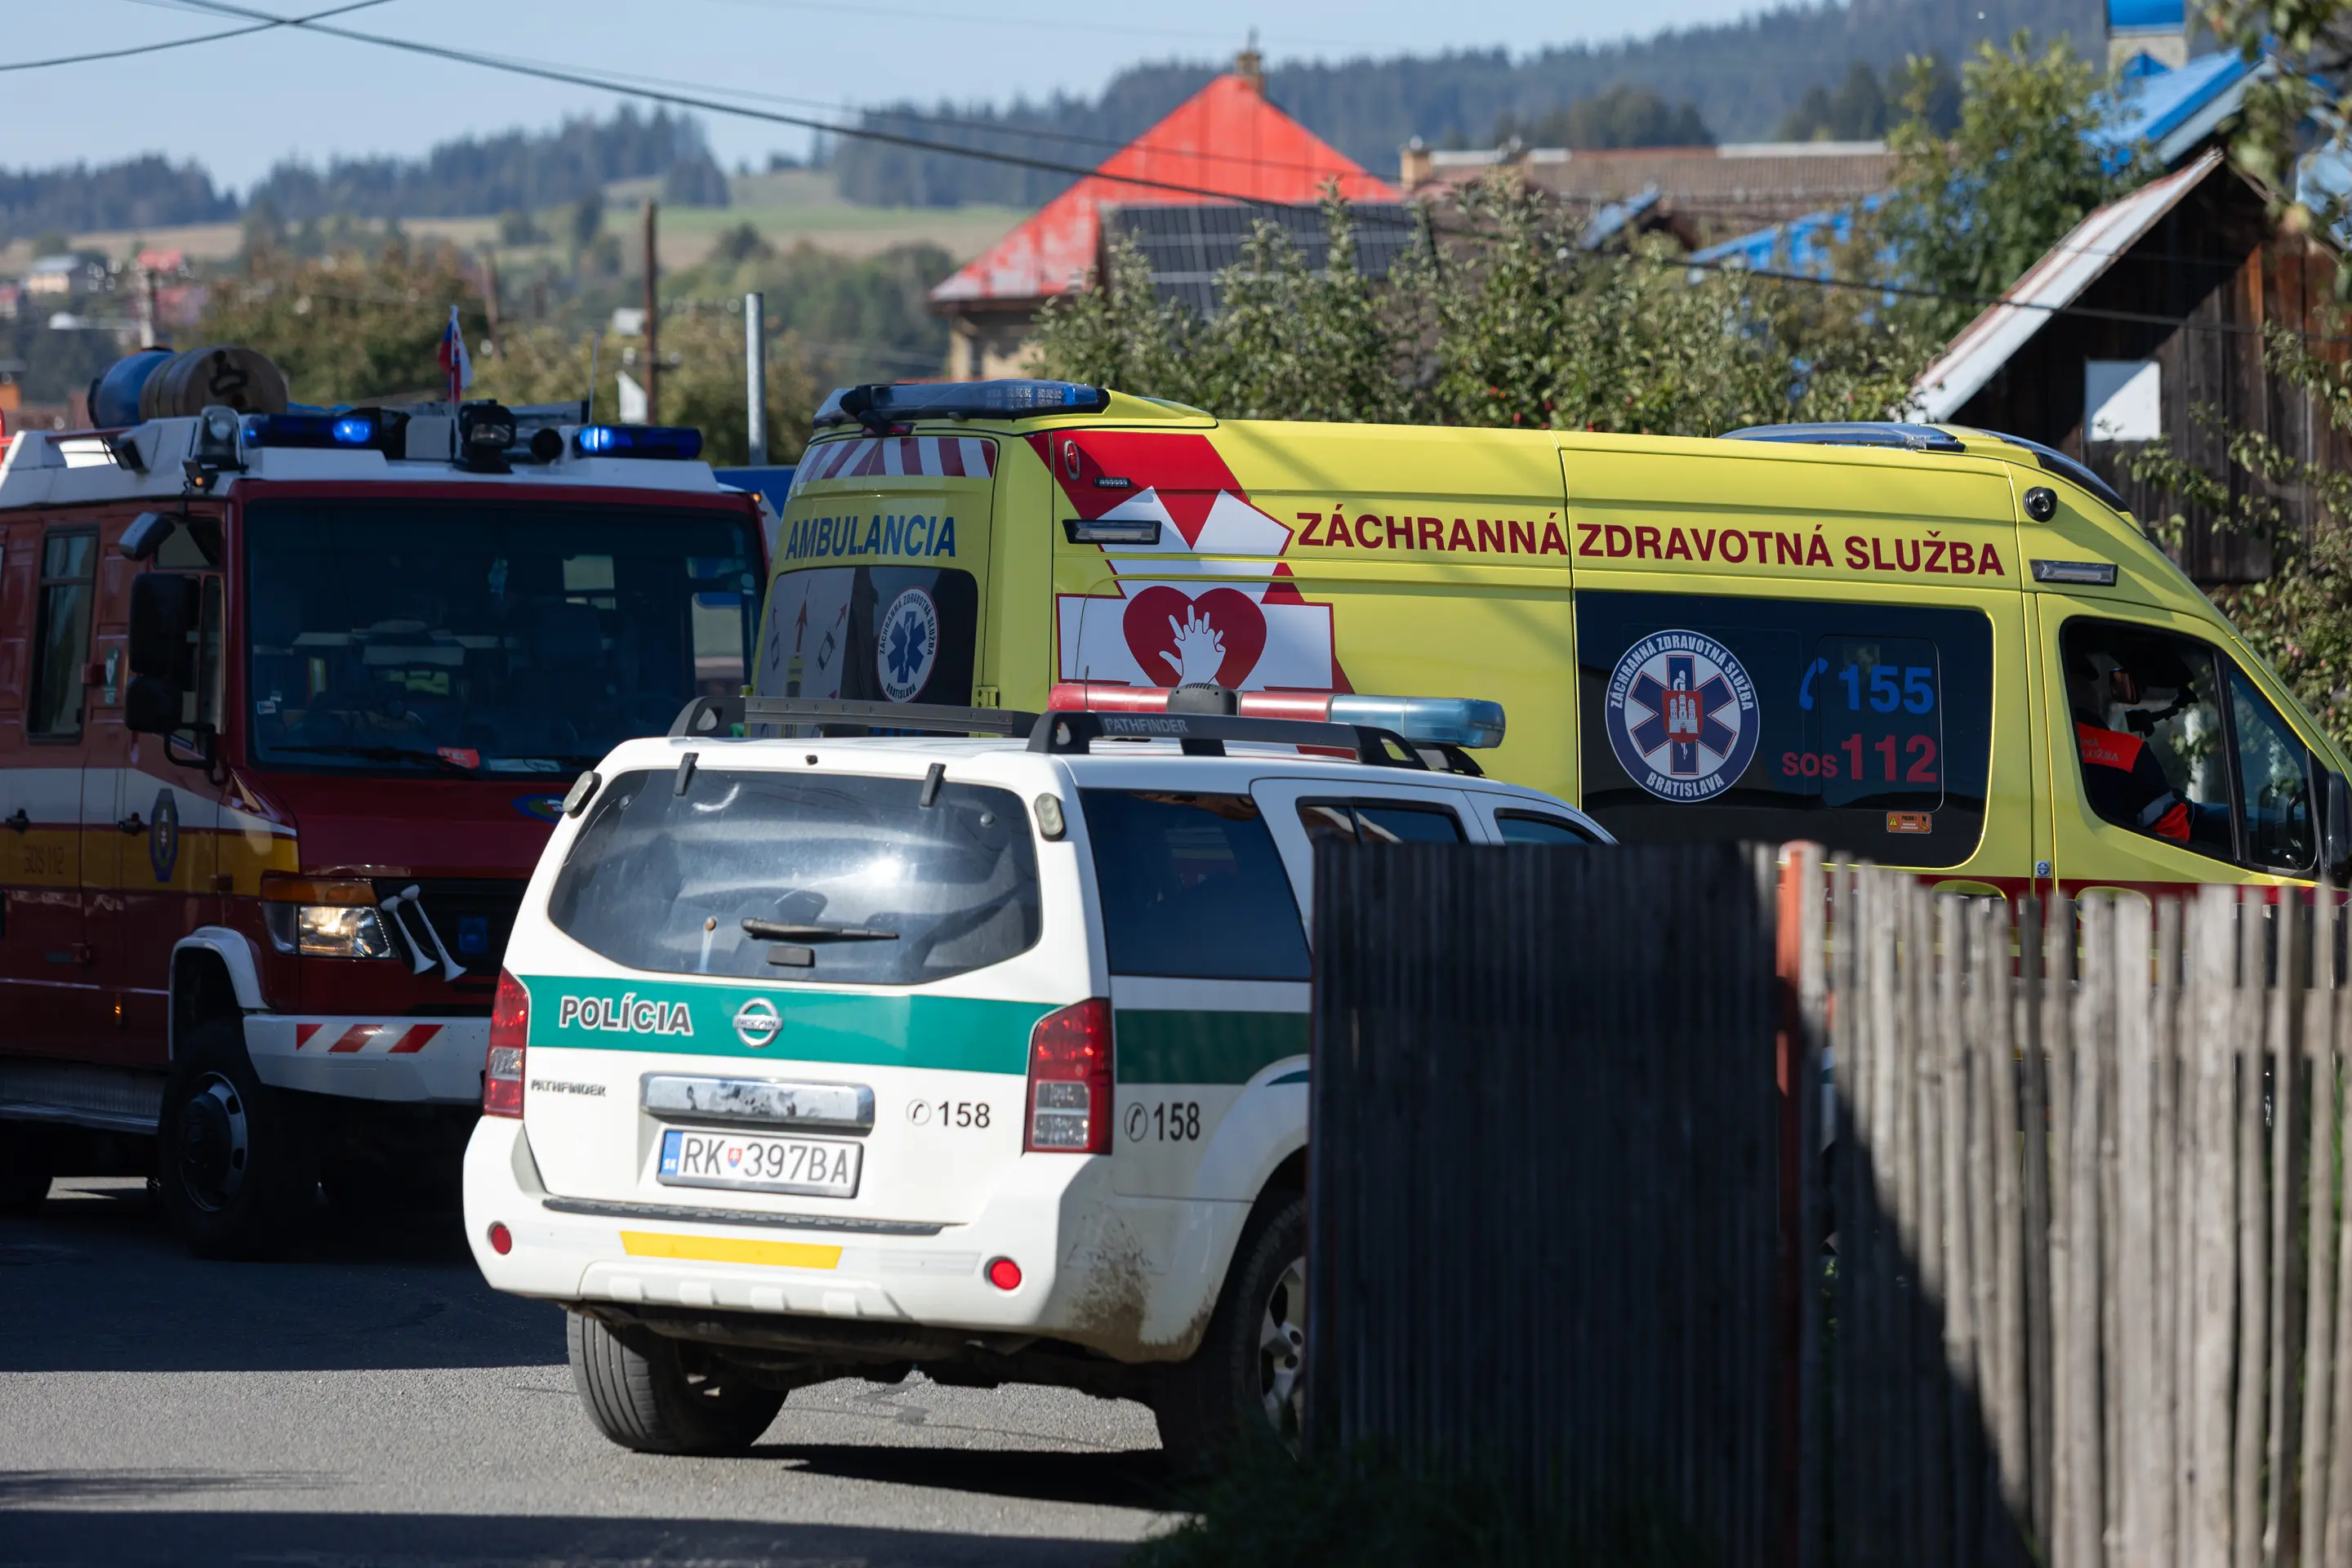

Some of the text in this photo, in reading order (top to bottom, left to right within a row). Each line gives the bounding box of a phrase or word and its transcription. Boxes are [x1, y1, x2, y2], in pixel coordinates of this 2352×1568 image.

[785, 514, 956, 560] AMBULANCIA
[1296, 503, 2006, 577] ZÁCHRANNÁ ZDRAVOTNÁ SLUŽBA
[927, 617, 937, 656] SLUŽBA
[886, 683, 916, 700] BRATISLAVA
[1610, 635, 1754, 710] ZÁCHRANNÁ ZDRAVOTNÁ SLUŽBA
[1838, 664, 1934, 715] 155
[1103, 718, 1190, 733] PATHFINDER
[1842, 733, 1937, 783] 112
[1646, 772, 1726, 797] BRATISLAVA
[559, 992, 693, 1036] POLÍCIA
[531, 1079, 607, 1097] PATHFINDER
[938, 1101, 991, 1129] 158
[1153, 1101, 1201, 1142] 158
[663, 1138, 849, 1184] SK RK 397BA
